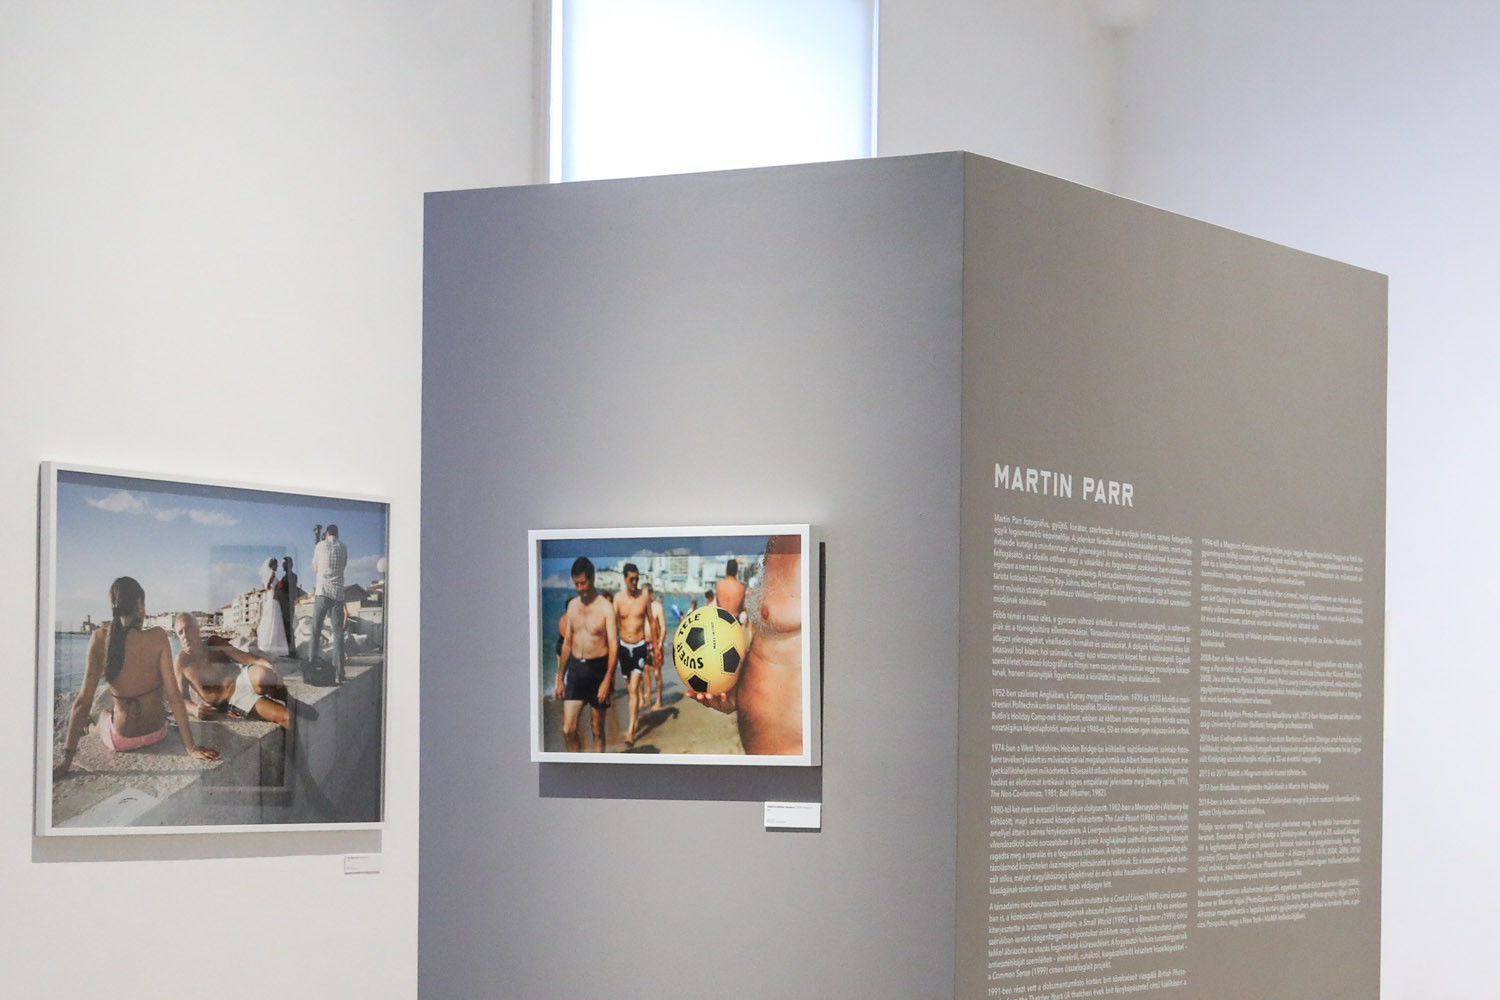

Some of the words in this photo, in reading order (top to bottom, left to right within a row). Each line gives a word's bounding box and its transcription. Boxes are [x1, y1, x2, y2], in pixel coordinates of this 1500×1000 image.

[994, 463, 1072, 498] MARTIN
[1082, 476, 1134, 508] PARR
[678, 613, 702, 637] TELE
[676, 643, 704, 669] SUPER
